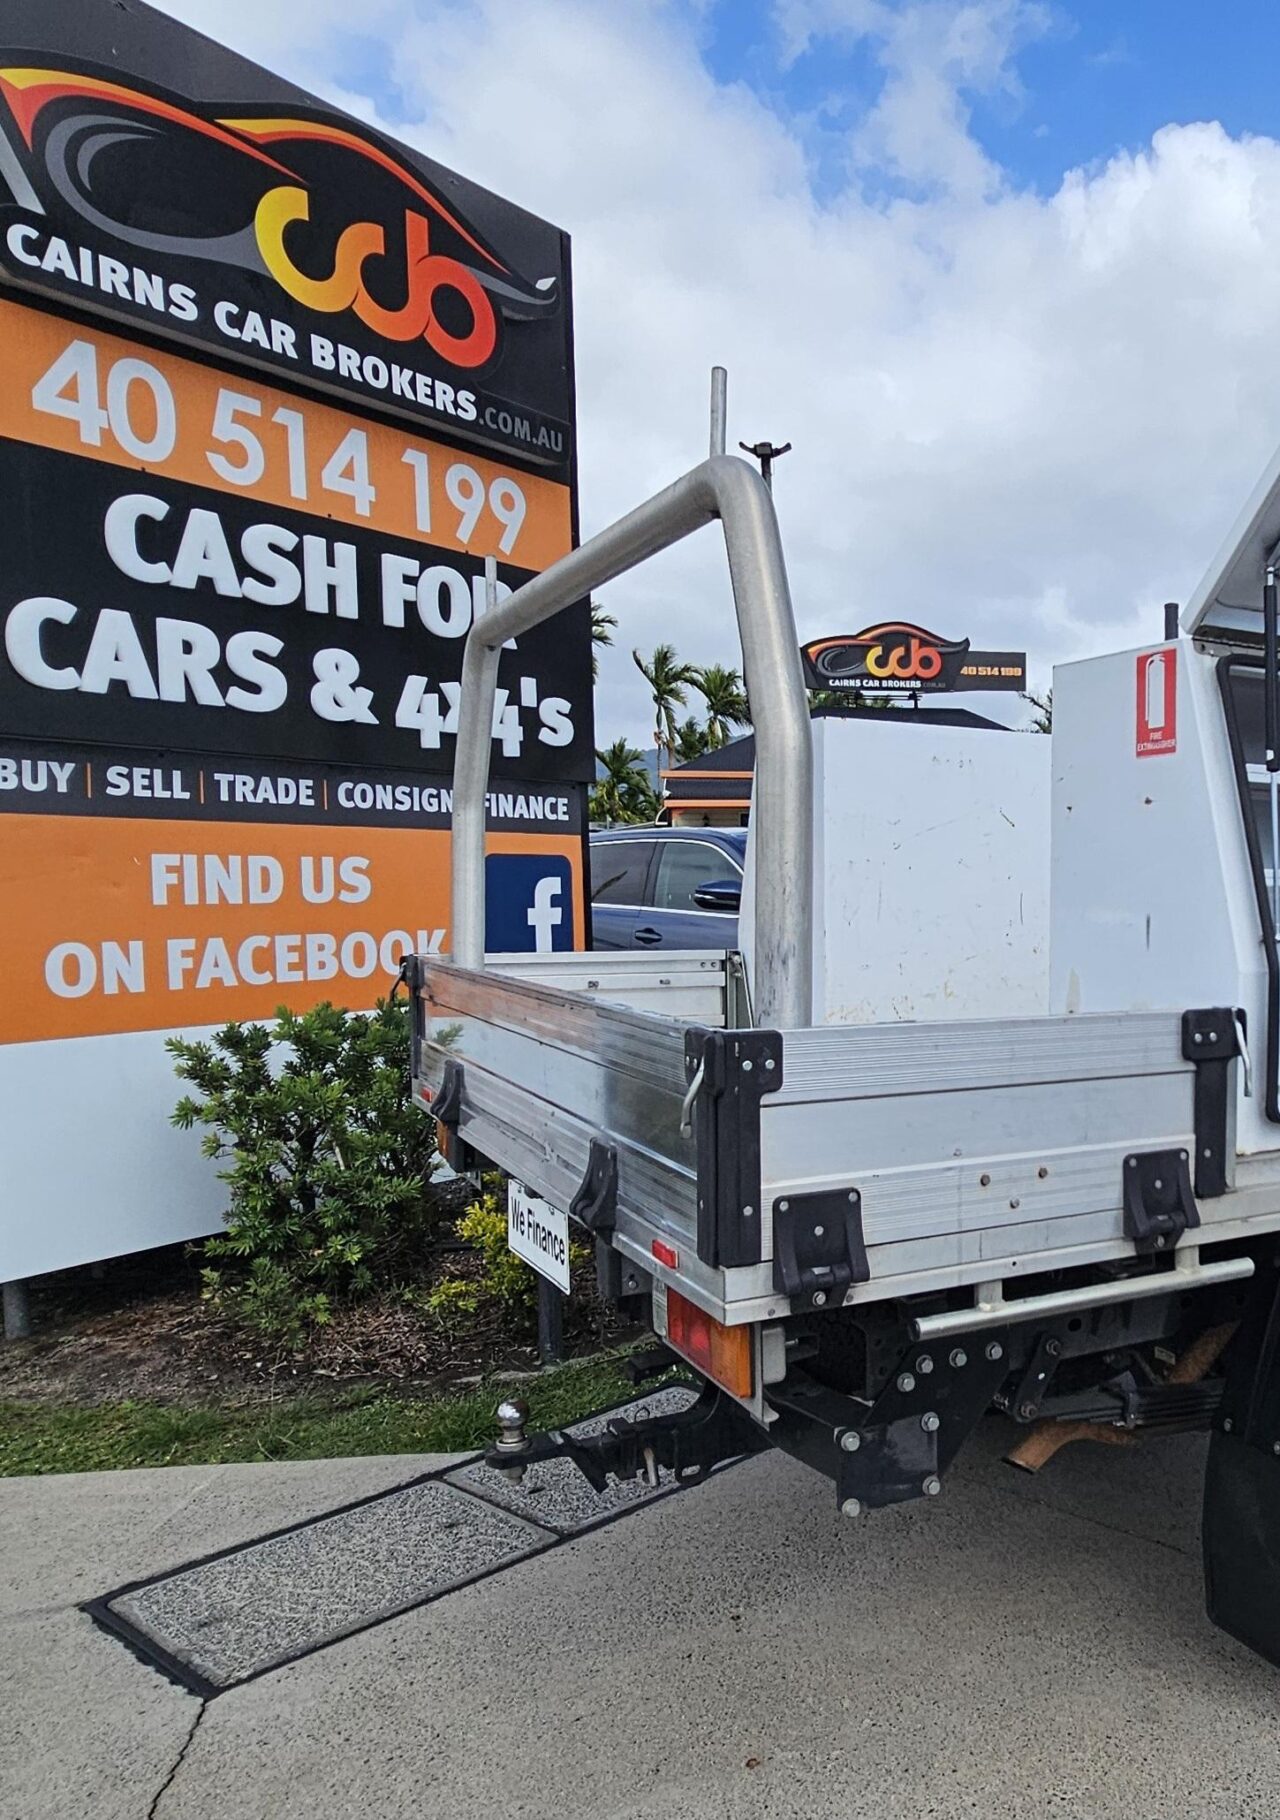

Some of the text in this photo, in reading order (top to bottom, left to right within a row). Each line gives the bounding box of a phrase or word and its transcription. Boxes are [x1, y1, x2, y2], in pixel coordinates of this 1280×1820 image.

[6, 223, 198, 322] CAIRNS
[213, 300, 299, 360] CAR
[31, 339, 527, 556] 40 514 199
[104, 494, 359, 620] CASH
[4, 596, 288, 713] CARS
[310, 648, 380, 725] &
[829, 679, 861, 688] CAIRNS
[862, 679, 880, 688] CAR
[882, 679, 921, 688] BROKERS
[0, 758, 76, 793] BUY
[105, 765, 191, 800] SELL
[213, 772, 315, 806] TRADE
[337, 781, 452, 813] CONSIGN
[150, 853, 372, 906] FIND US
[44, 928, 447, 998] ON FACEBOOK
[511, 1196, 565, 1266] We Finance
